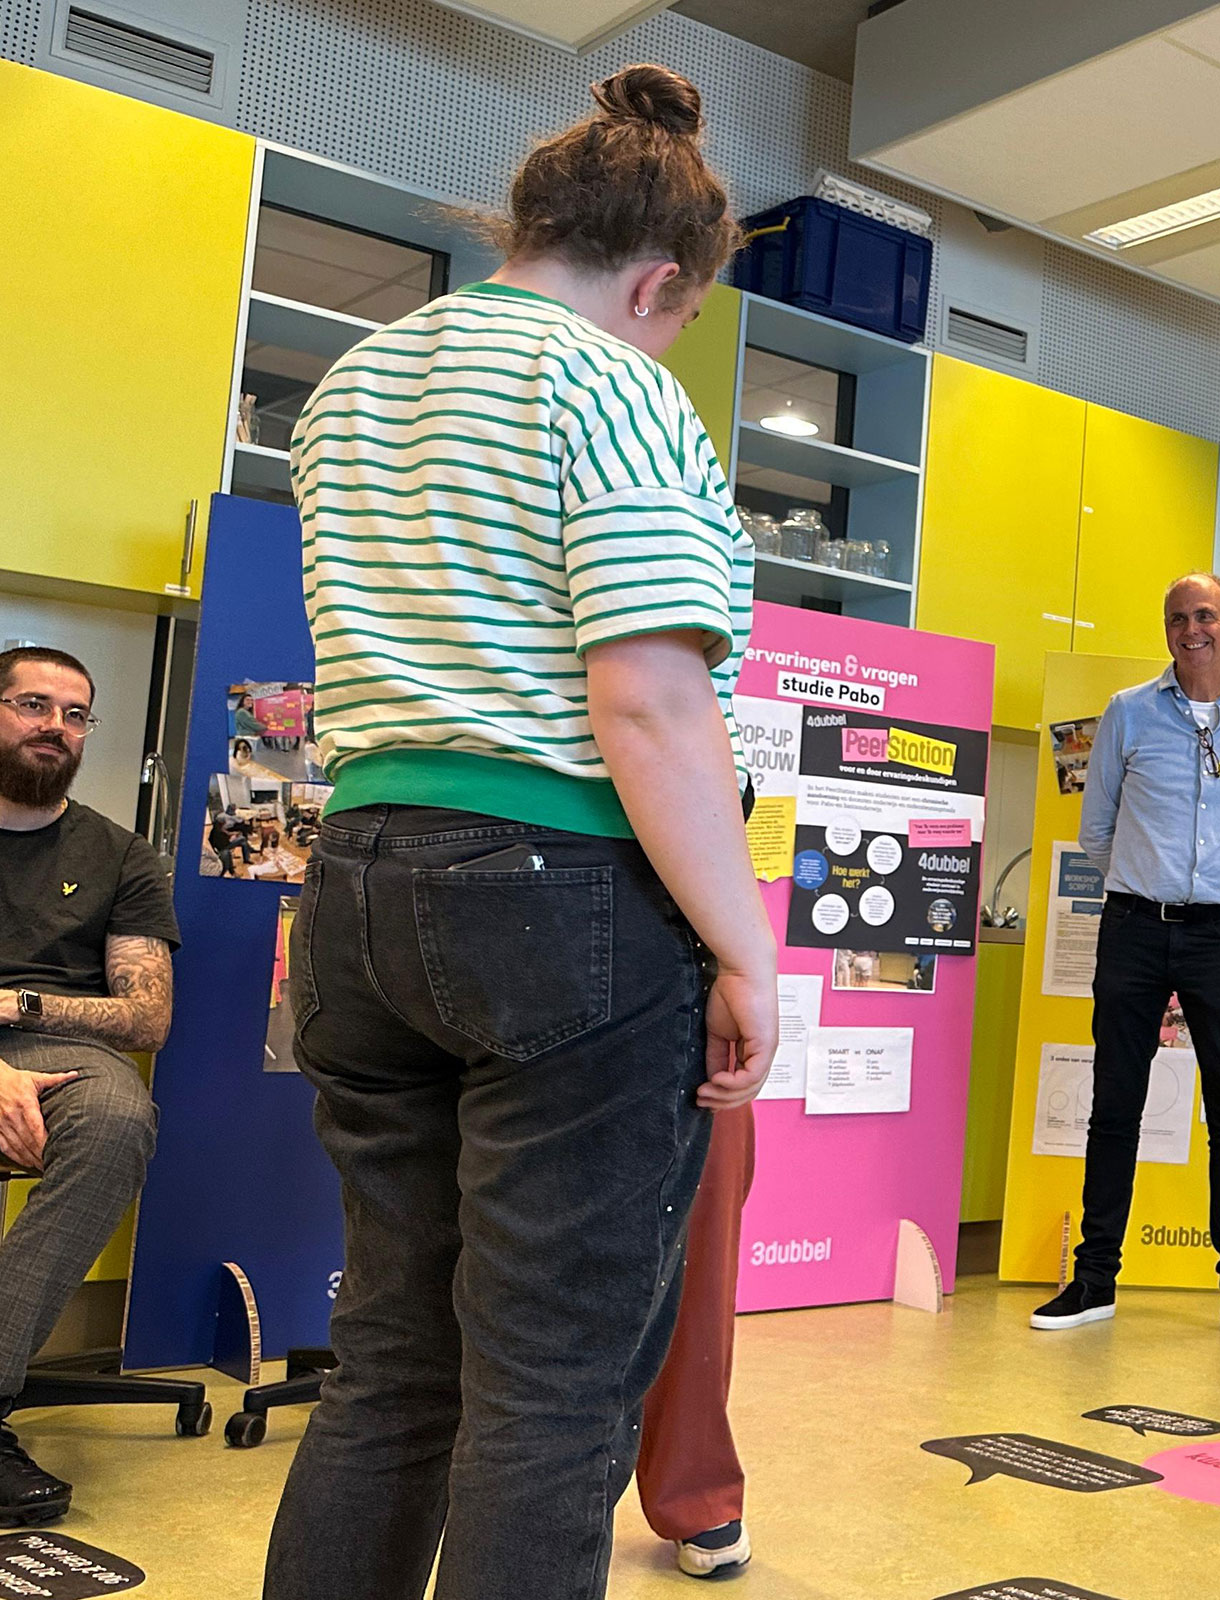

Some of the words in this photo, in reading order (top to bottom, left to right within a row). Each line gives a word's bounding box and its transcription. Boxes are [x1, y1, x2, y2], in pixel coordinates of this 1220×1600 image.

[744, 647, 841, 675] ervaringen
[844, 654, 859, 677] &
[860, 665, 918, 688] vragen
[782, 677, 834, 698] studie
[838, 684, 880, 706] Pabo
[806, 713, 847, 728] 4dubbel
[746, 748, 796, 773] JOUW
[839, 765, 855, 774] voor
[857, 767, 866, 775] en
[866, 767, 882, 778] door
[832, 865, 848, 876] Hoe
[918, 852, 970, 874] 4dubbel
[842, 878, 861, 889] het?
[1140, 1224, 1211, 1248] 3dubbe
[751, 1236, 832, 1266] 3dubbel
